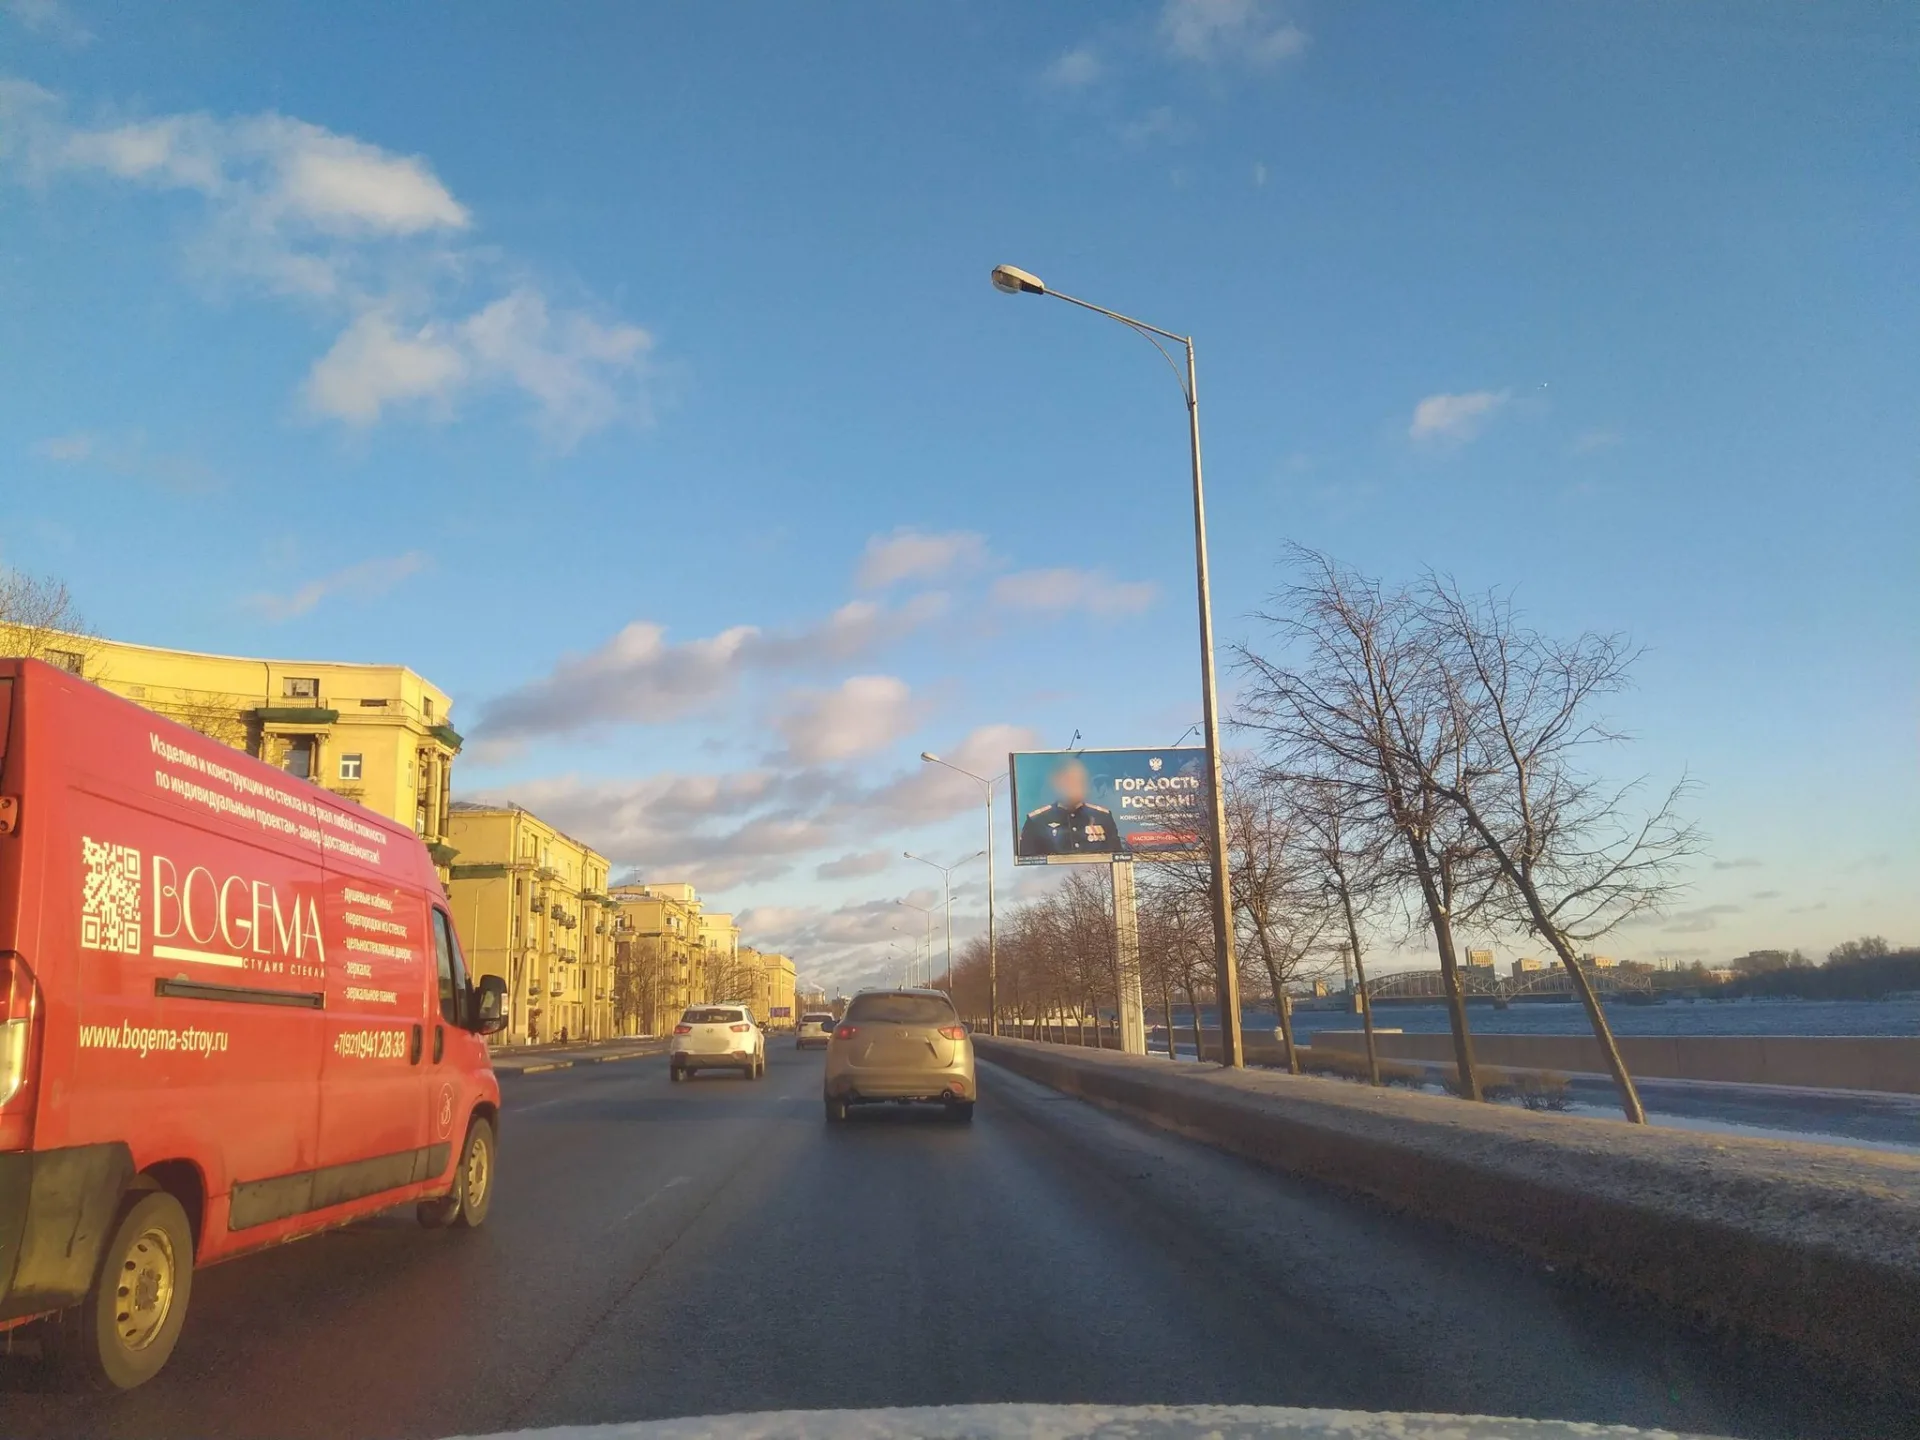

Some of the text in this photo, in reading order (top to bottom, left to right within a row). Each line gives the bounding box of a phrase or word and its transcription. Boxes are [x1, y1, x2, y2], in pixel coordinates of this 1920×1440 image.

[150, 731, 198, 769] Изделия
[198, 758, 206, 772] и
[206, 761, 264, 796] конструкции
[264, 785, 275, 801] из
[275, 790, 302, 812] стекла
[307, 803, 333, 824] зеркал
[333, 813, 354, 832] любой
[354, 823, 386, 845] сложности
[156, 771, 170, 790] по
[171, 776, 256, 821] индивидуальным
[1114, 776, 1199, 791] ГОРДОСТЬ
[1121, 794, 1195, 808] РОССИИ!
[153, 855, 325, 962] BOGEMA
[243, 957, 325, 978] СТУДИЯ СТЕКЛА
[79, 1018, 228, 1059] www.bogema-stroy.ru
